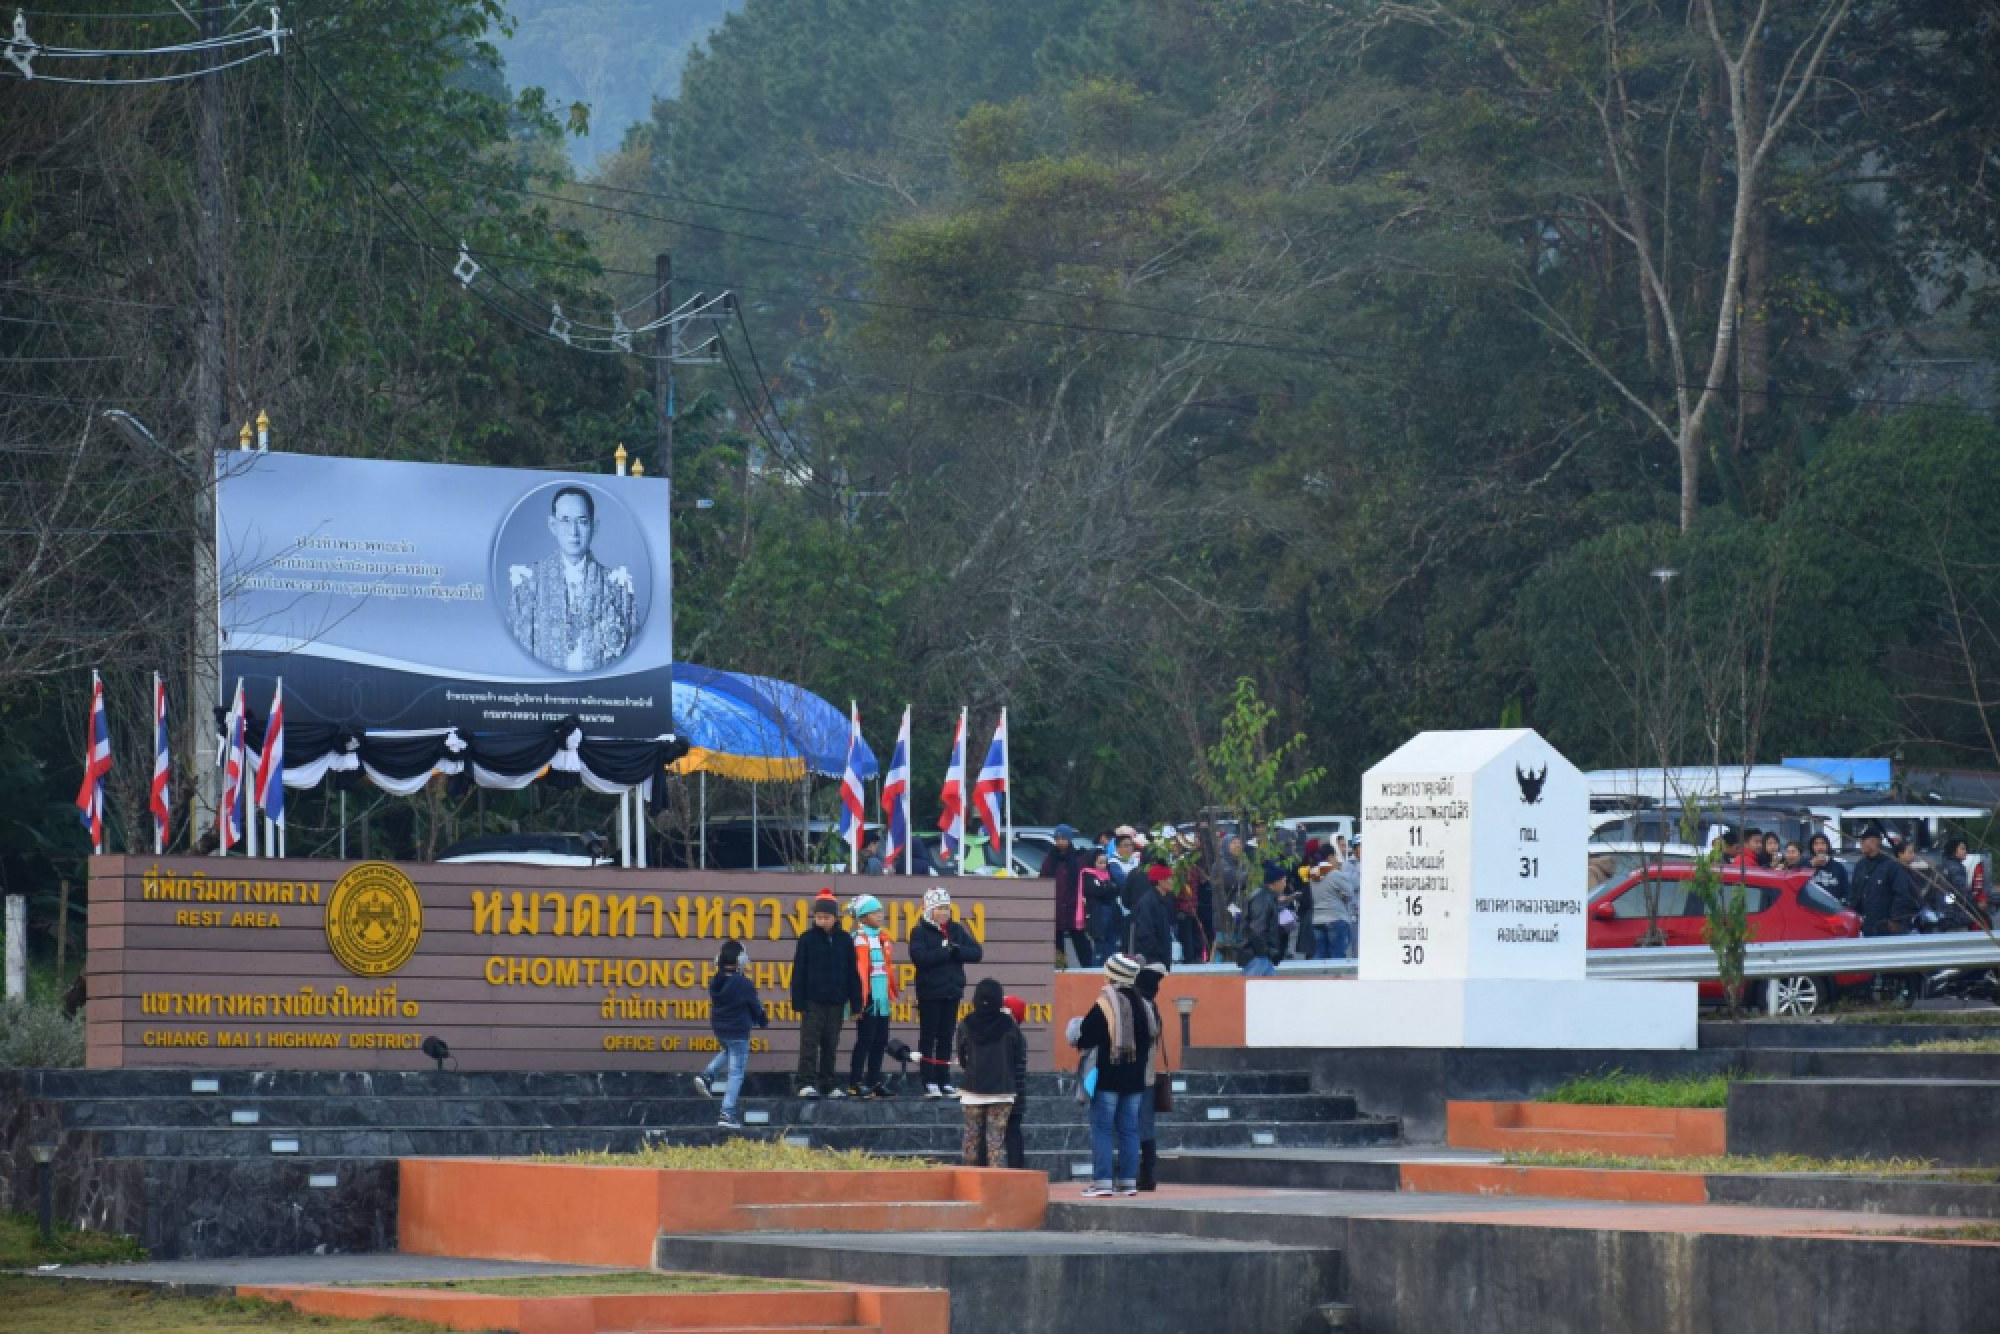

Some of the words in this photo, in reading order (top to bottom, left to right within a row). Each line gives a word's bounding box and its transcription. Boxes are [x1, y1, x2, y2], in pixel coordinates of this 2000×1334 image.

[1408, 826, 1422, 847] 11
[1519, 856, 1538, 878] 31
[142, 863, 320, 904] ที่พักริมทางหลวง
[1406, 896, 1423, 916] 16
[176, 909, 224, 927] REST
[231, 911, 281, 928] AREA
[1402, 944, 1424, 965] 30
[485, 956, 696, 989] CHOMTHONG
[141, 982, 397, 1018] แขวงทางหลวงเชียงใหม่ที่
[401, 1001, 420, 1018] ๑
[143, 1031, 209, 1047] CHIANG
[217, 1032, 249, 1047] MAI
[254, 1032, 262, 1047] 1
[267, 1032, 342, 1048] HIGHWAY
[350, 1033, 421, 1049] DISTRICT
[603, 1035, 657, 1051] OFFICE
[661, 1035, 681, 1051] OF
